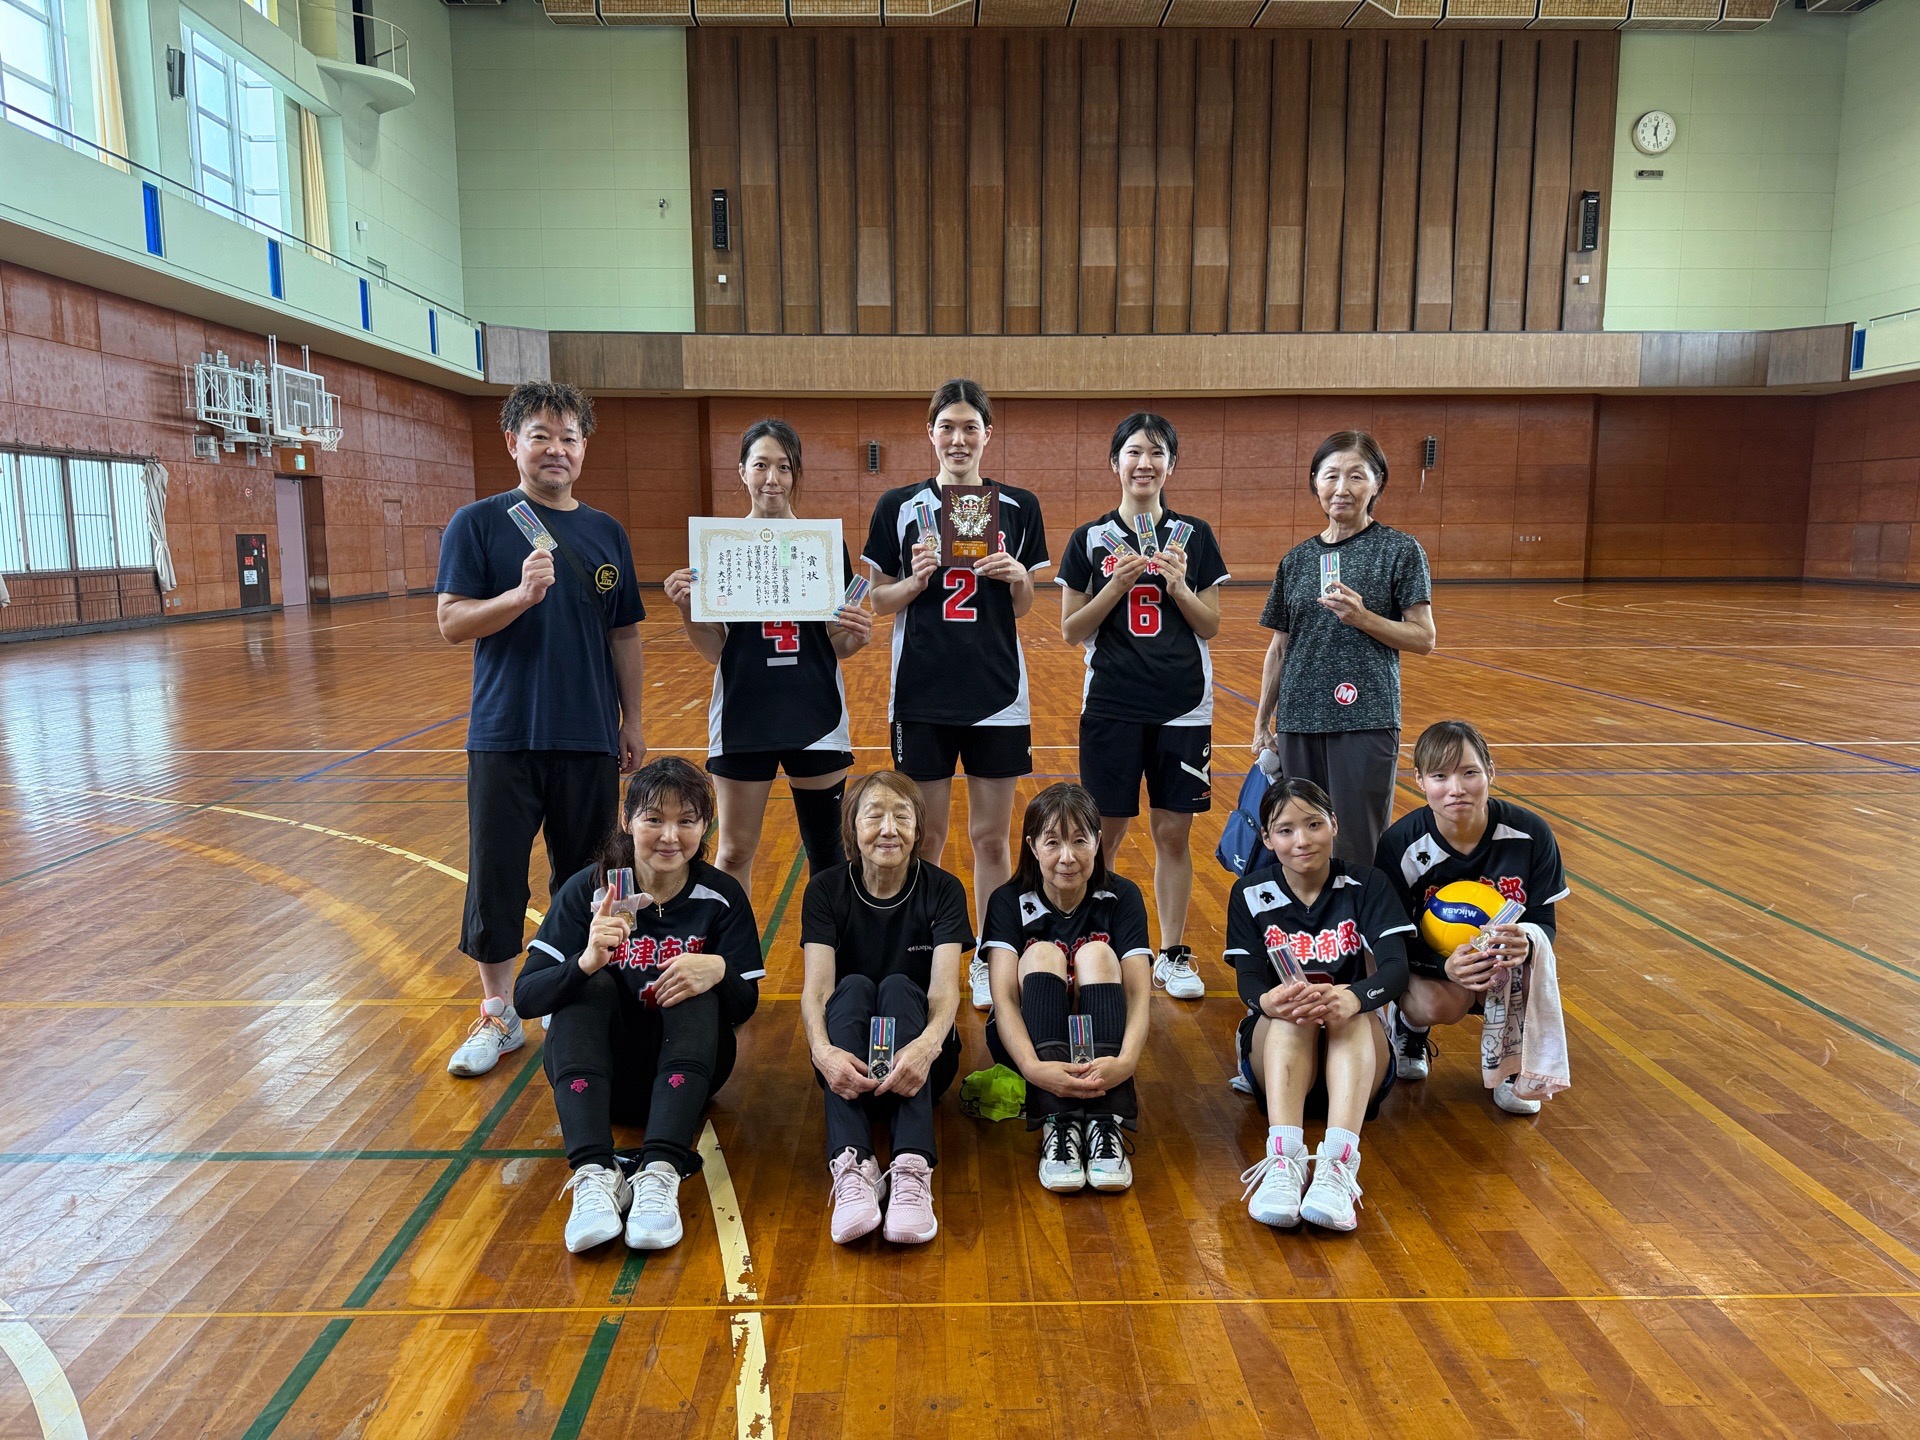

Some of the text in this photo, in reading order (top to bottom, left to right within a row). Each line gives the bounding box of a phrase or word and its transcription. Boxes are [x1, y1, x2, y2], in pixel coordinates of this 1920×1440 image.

[806, 555, 819, 581] 賞状
[943, 567, 977, 622] 2
[1128, 584, 1162, 637] 6
[1337, 686, 1355, 702] M
[1265, 919, 1362, 965] 御津南部
